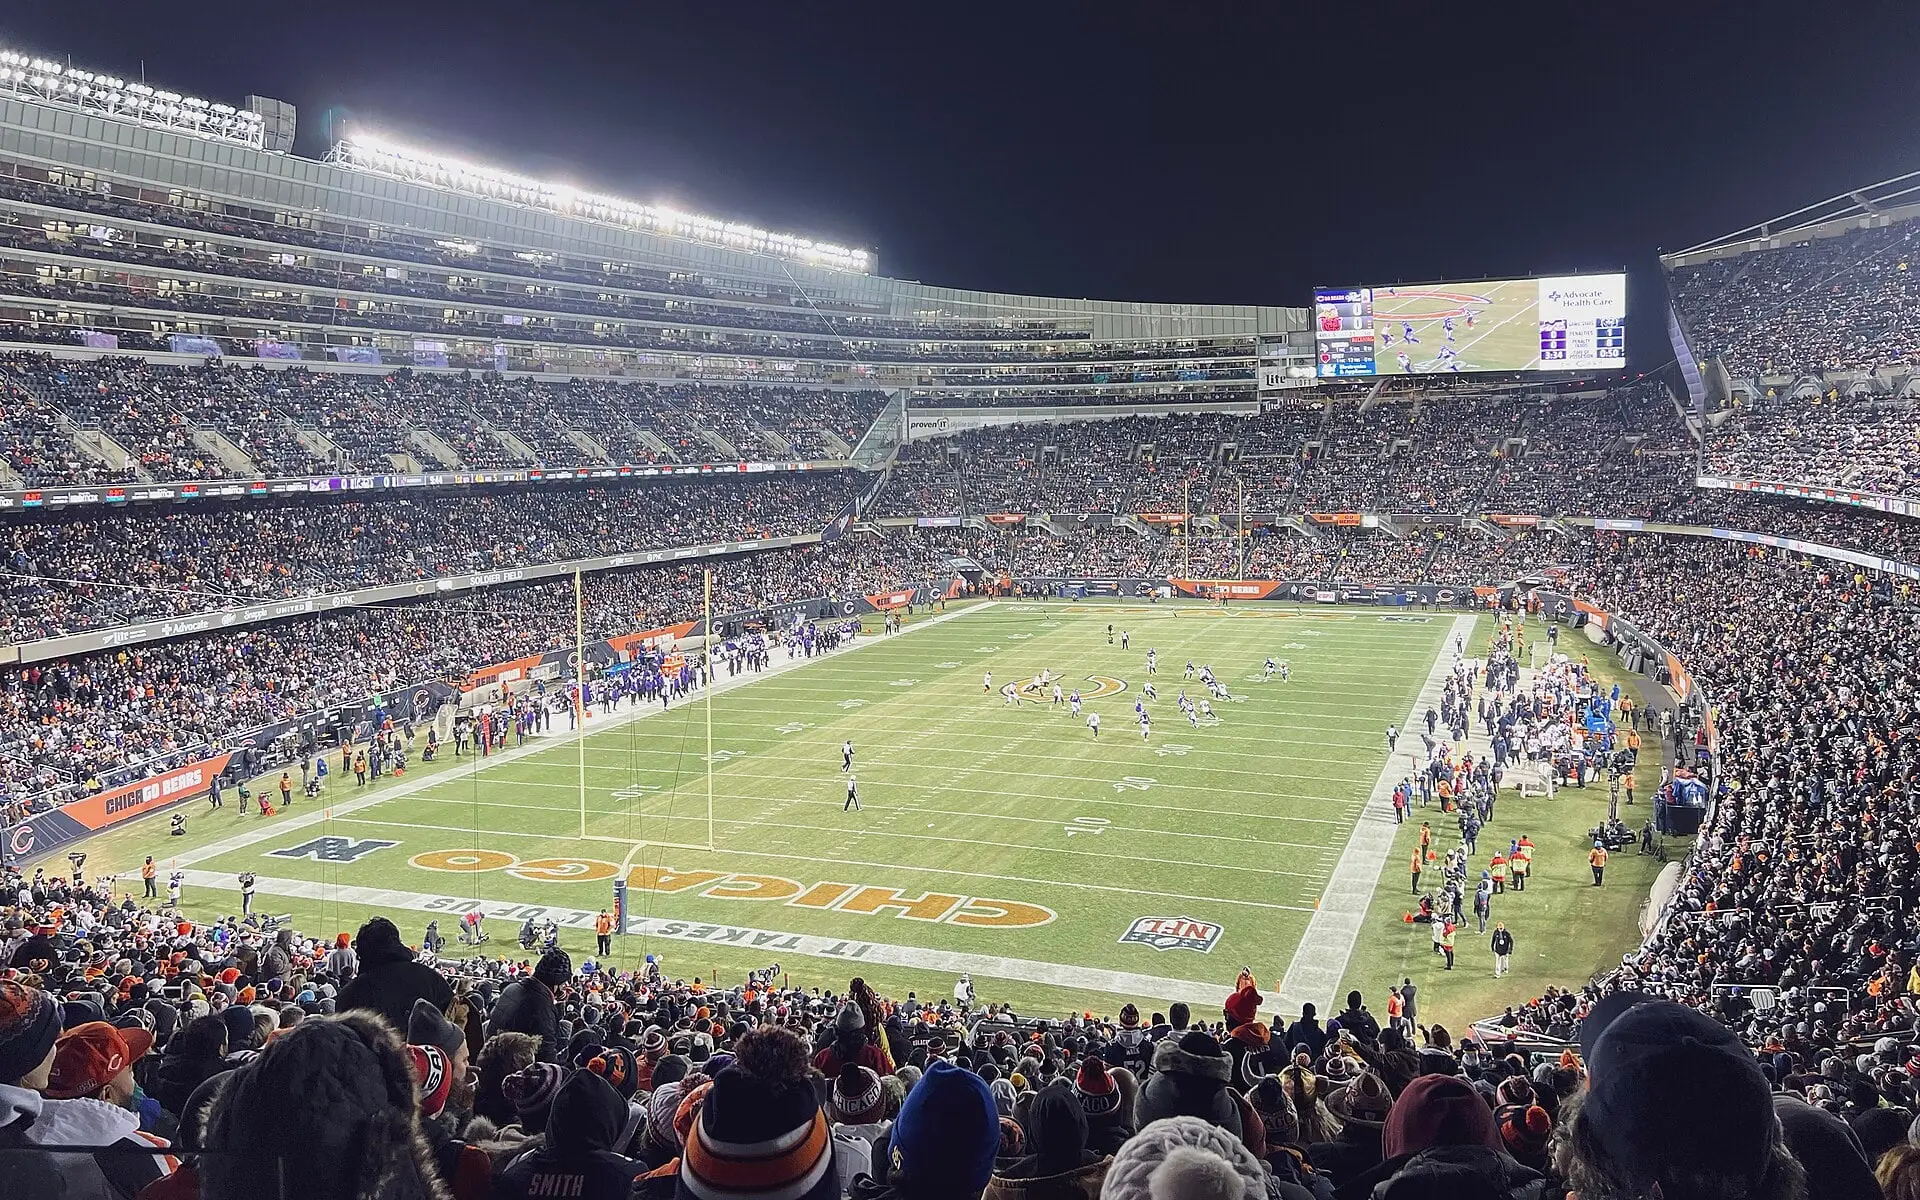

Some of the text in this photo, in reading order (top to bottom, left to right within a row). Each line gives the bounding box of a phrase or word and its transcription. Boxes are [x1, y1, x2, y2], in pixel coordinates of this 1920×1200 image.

[1563, 290, 1603, 299] Advocate
[1353, 303, 1362, 316] 0
[1563, 298, 1613, 308] Health Care
[1354, 317, 1363, 330] 0
[1545, 351, 1564, 360] 3:34
[1600, 349, 1620, 357] 0:50
[1266, 374, 1312, 387] Lite LOFT
[910, 421, 937, 430] proven
[939, 420, 947, 428] IT
[470, 570, 523, 586] SOLDIER FIELD
[340, 595, 356, 605] PNC
[275, 603, 305, 615] UNITED
[173, 619, 209, 634] Advocate
[113, 631, 129, 645] Lite
[1112, 776, 1158, 791] 20
[105, 769, 202, 815] CHICAGO BEARS
[610, 784, 662, 799] 10
[1064, 816, 1112, 833] 10
[407, 849, 1059, 929] CHICAGO
[424, 897, 482, 914] US
[656, 921, 802, 951] TAKES
[1146, 919, 1211, 940] NFL
[820, 940, 874, 959] IT
[528, 1172, 585, 1197] SMITH
